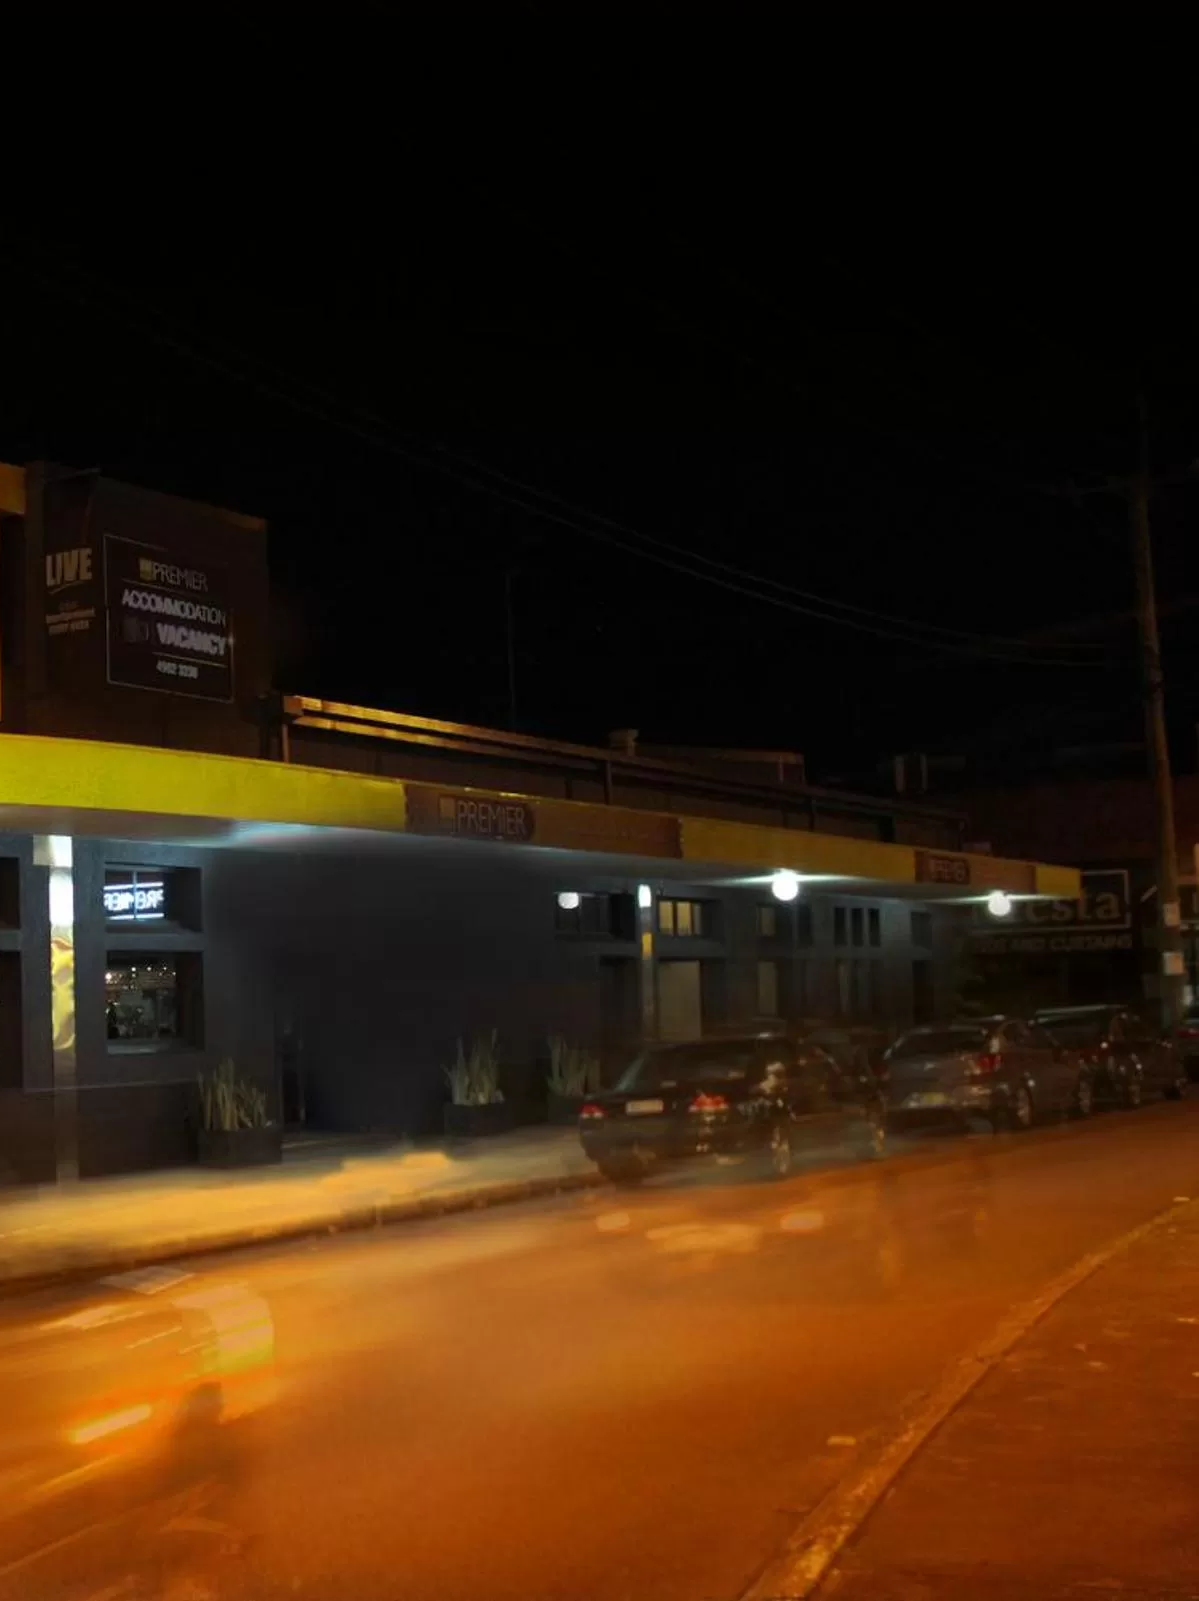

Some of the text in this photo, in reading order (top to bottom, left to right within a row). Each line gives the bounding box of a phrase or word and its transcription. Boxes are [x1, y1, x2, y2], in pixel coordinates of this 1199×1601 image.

[46, 547, 93, 588] LIVE
[152, 561, 208, 593] PREMIER
[121, 588, 227, 628] ACCOMMODATION
[156, 622, 227, 656] VACANCY
[456, 801, 527, 835] PREMIER
